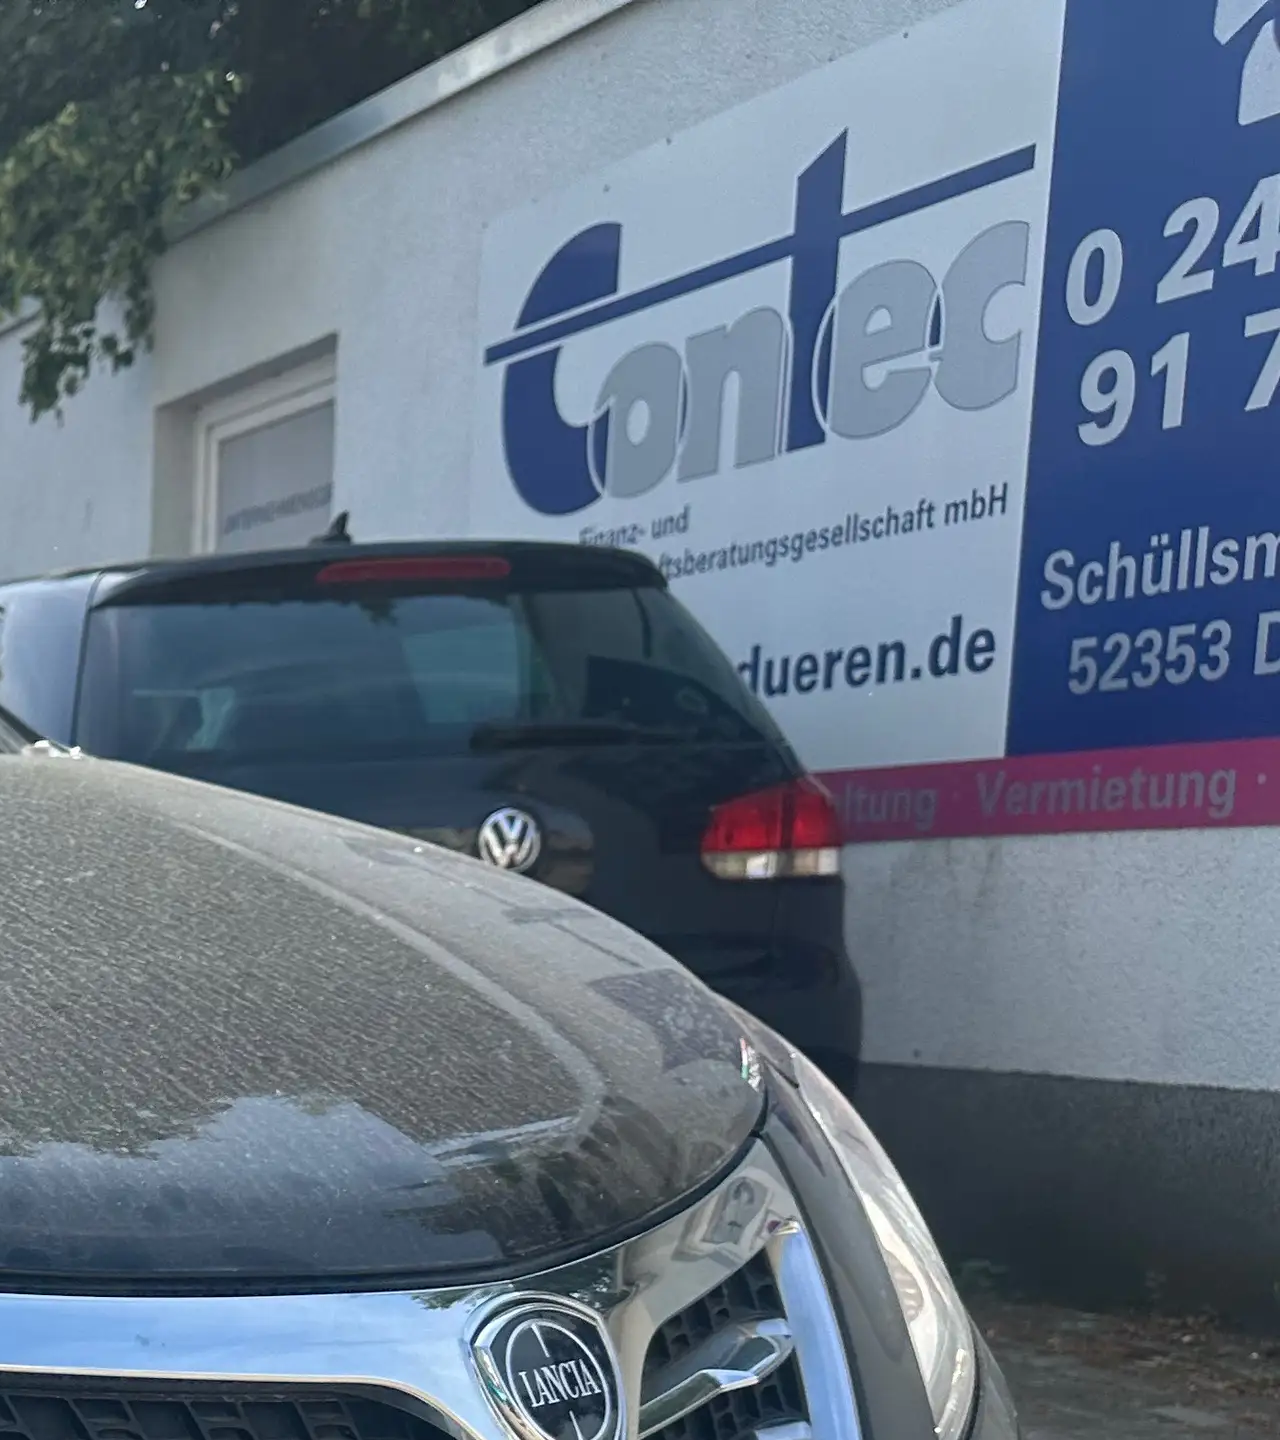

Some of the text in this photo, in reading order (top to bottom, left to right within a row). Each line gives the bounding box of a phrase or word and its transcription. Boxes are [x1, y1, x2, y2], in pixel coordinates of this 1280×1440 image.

[1066, 228, 1124, 327] 0
[484, 127, 1036, 517] Contec
[1078, 332, 1190, 446] 91
[652, 503, 690, 540] und
[944, 482, 1009, 525] mbH
[1068, 619, 1232, 695] 52353
[976, 764, 1237, 819] Vermietung
[518, 1358, 601, 1408] LANCIA
